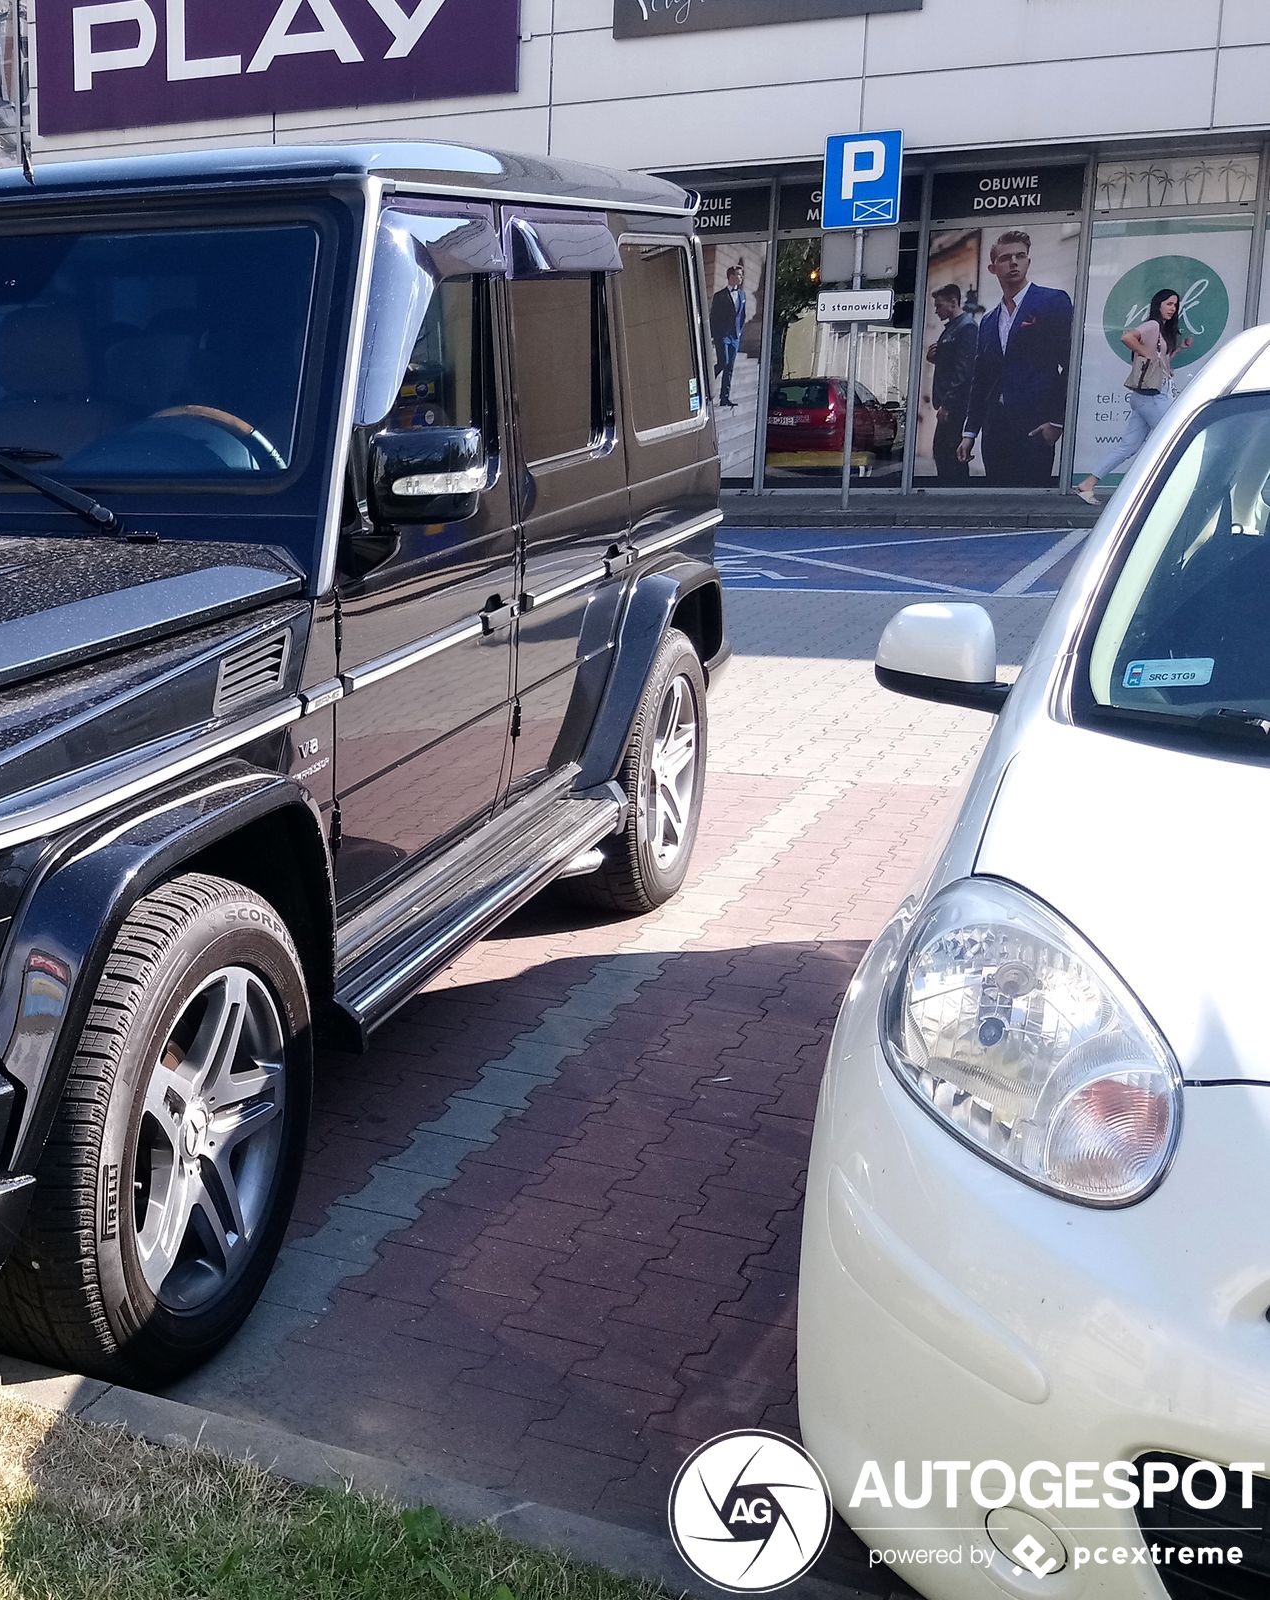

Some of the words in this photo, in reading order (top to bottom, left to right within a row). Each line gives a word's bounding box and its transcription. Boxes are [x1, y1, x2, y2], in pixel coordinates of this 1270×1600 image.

[73, 0, 446, 92] PLAY
[842, 140, 885, 199] P
[978, 175, 1039, 191] OBUWIE
[699, 197, 732, 211] ZULE
[973, 193, 1041, 210] DODATKI
[693, 214, 732, 228] ODNIE
[820, 303, 826, 312] 3
[831, 302, 889, 312] stanowiska
[1148, 673, 1169, 681] SRC
[1170, 672, 1196, 681] 3TG9
[297, 738, 319, 759] V8
[101, 1164, 119, 1243] PIRELLI
